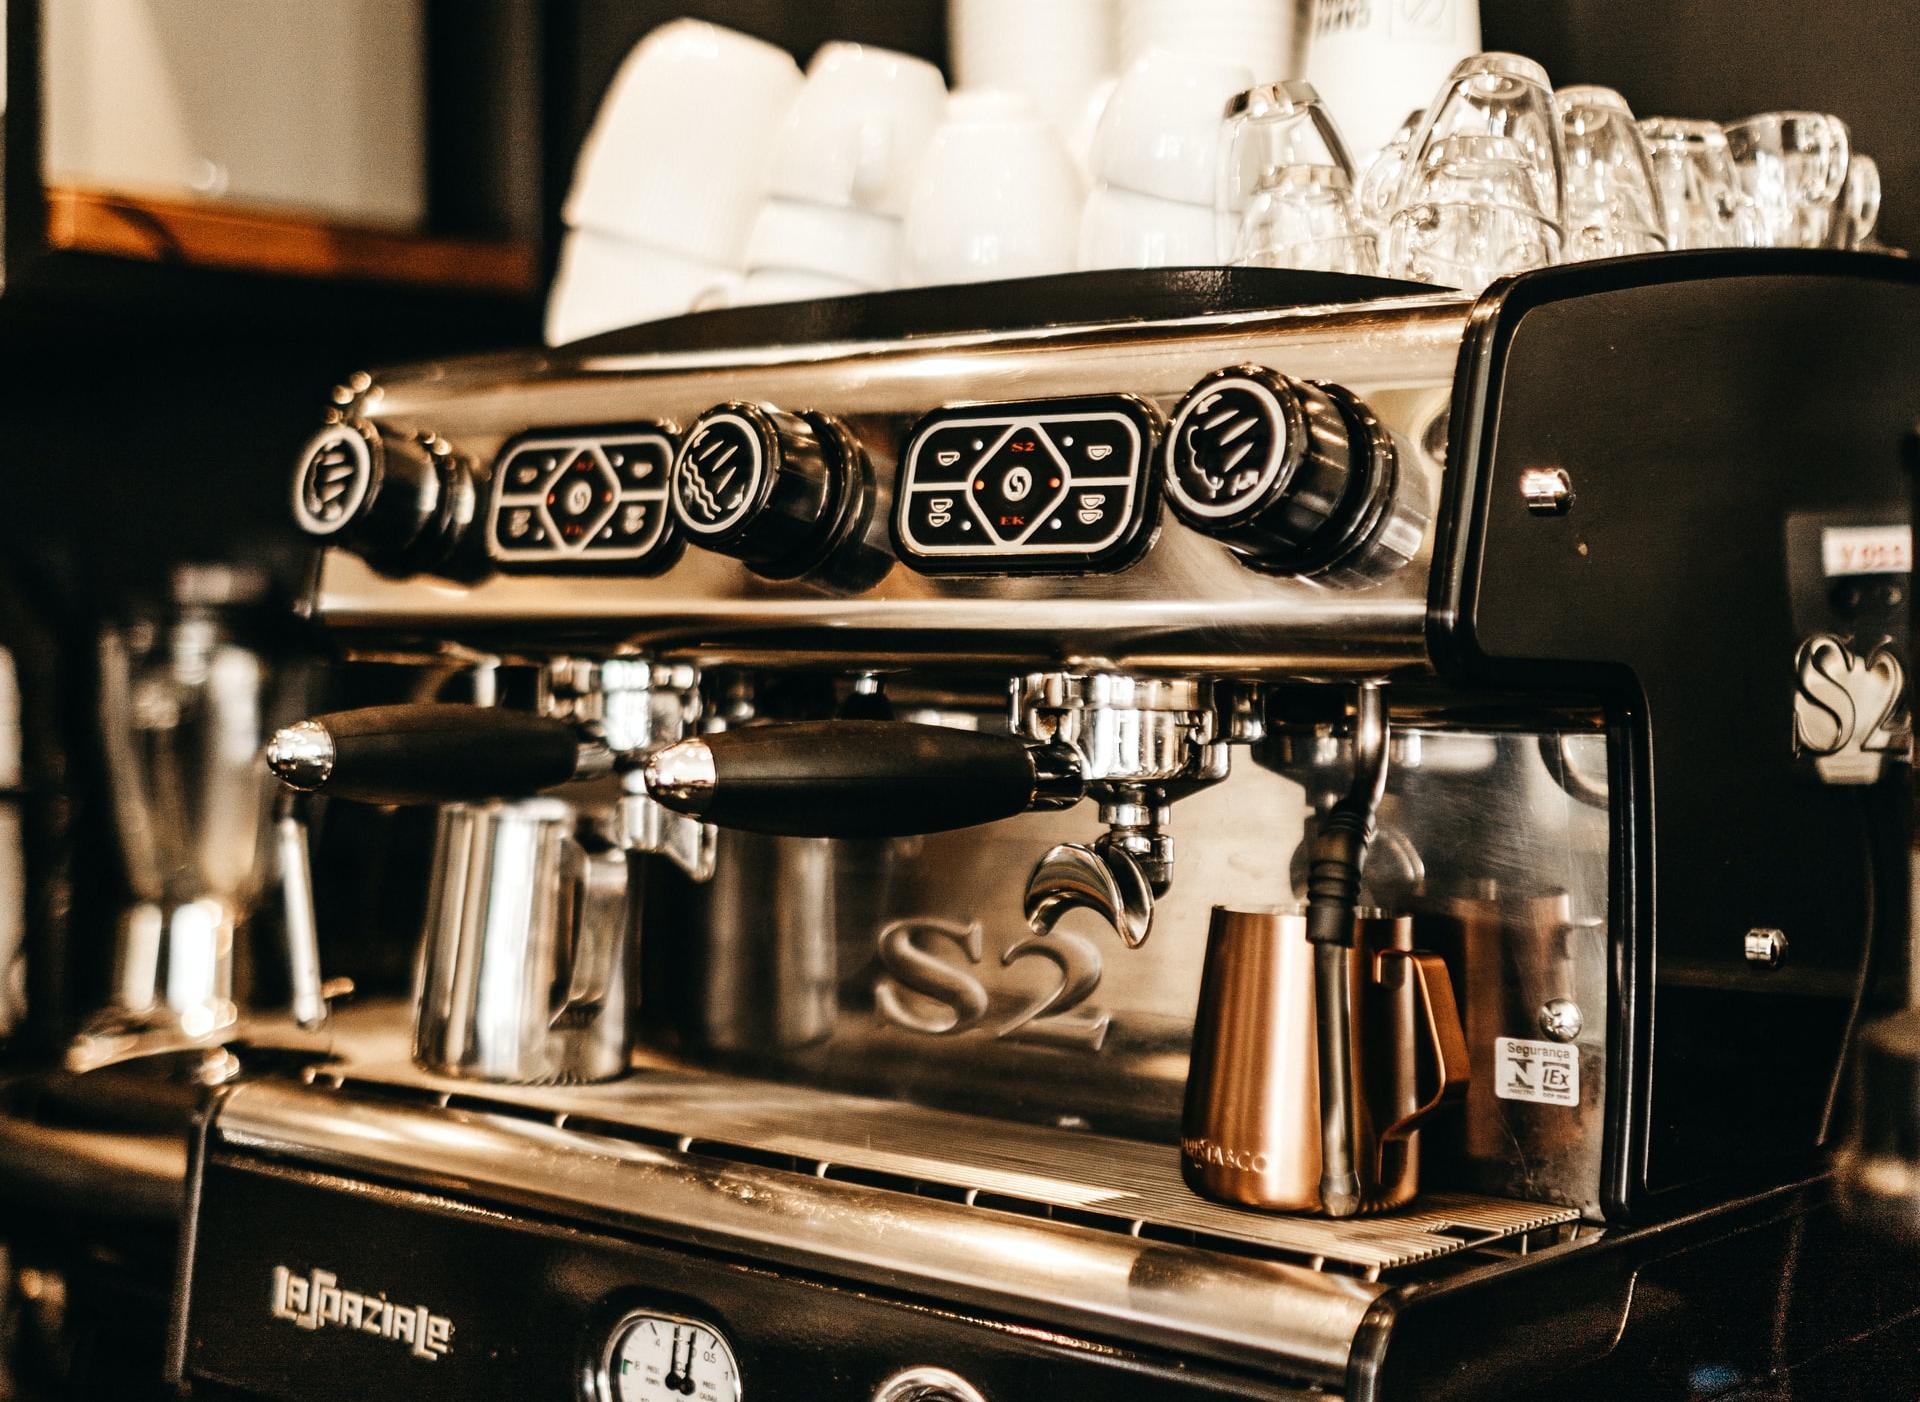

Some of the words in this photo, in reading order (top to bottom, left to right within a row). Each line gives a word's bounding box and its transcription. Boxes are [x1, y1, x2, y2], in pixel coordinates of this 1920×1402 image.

[1010, 441, 1035, 452] S2
[1794, 634, 1913, 760] S2
[874, 917, 1111, 1050] S2
[1507, 1042, 1570, 1058] Segurança
